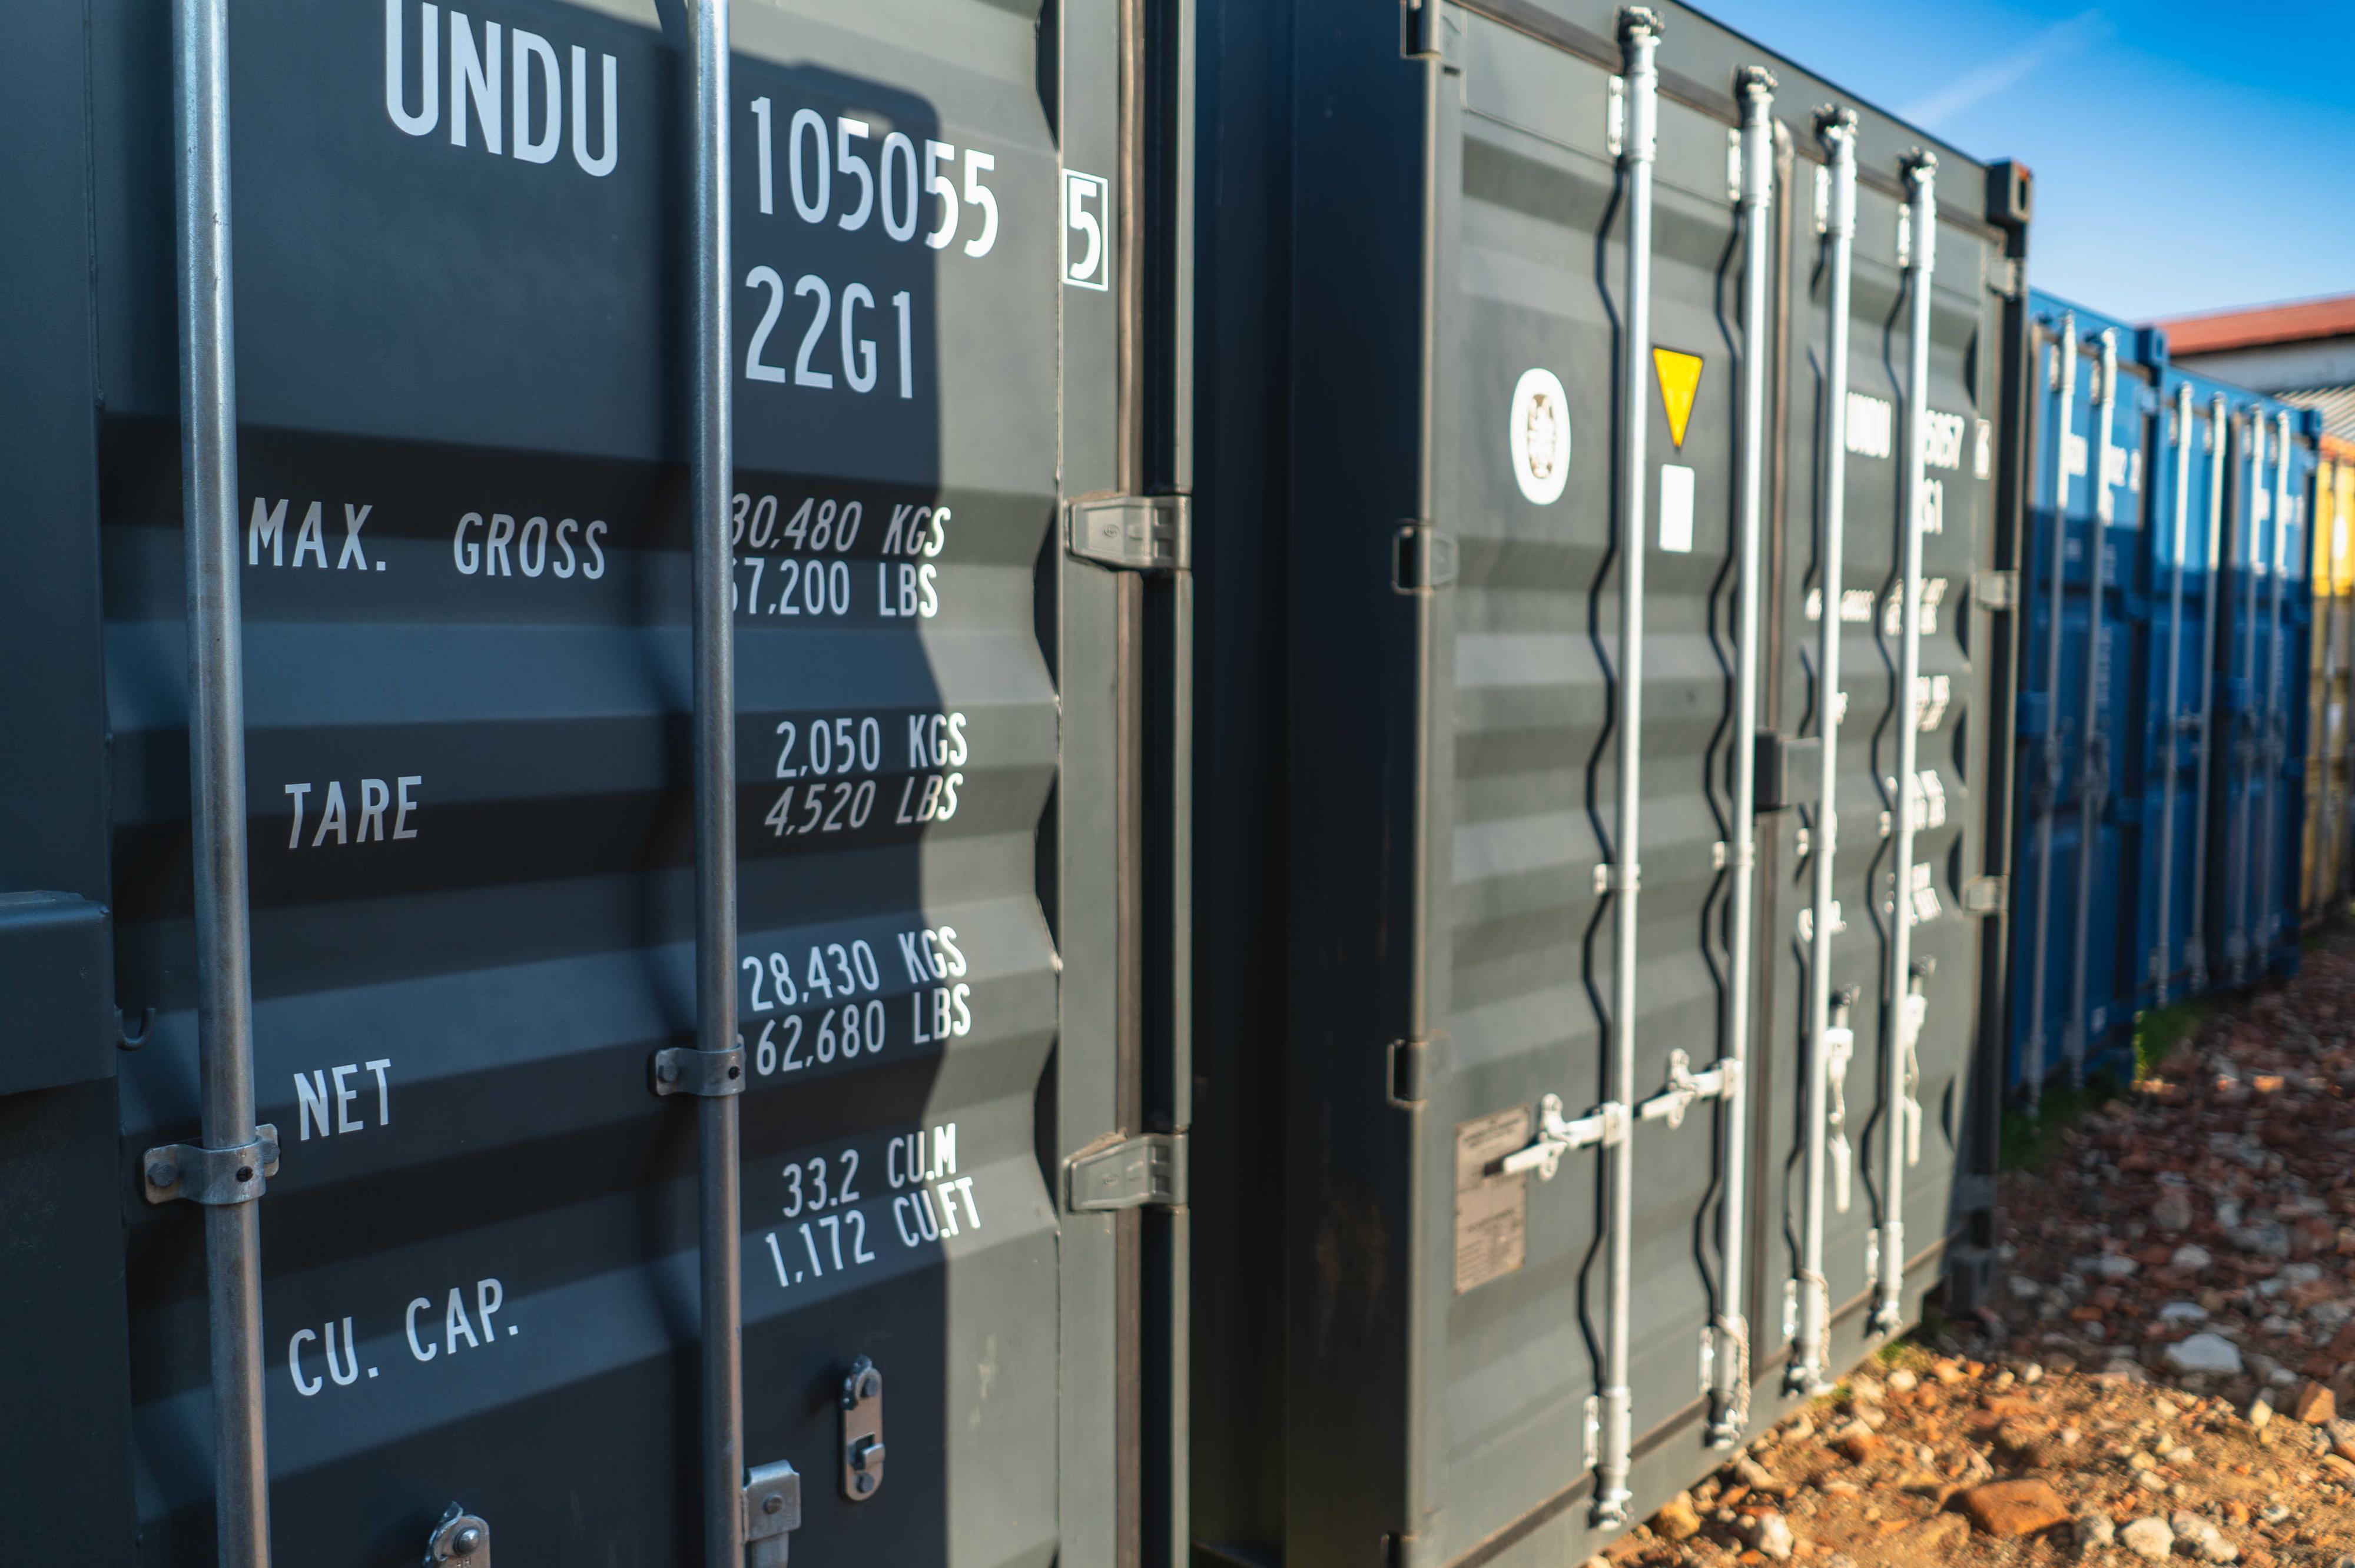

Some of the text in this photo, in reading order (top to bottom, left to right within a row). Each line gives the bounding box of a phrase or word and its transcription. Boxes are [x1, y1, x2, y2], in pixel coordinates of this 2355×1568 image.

[386, 0, 1100, 280] UNDU 105055 5
[745, 265, 913, 399] 22G1
[248, 497, 607, 580] MAX. GROSS
[732, 493, 951, 557] 30,480 KGS
[733, 557, 938, 617] 7,200 LBS
[776, 712, 967, 778] 2,050 KGS
[284, 775, 422, 849] TARE
[765, 772, 964, 836] 4,520 LBS
[742, 925, 967, 1012] 28,430 KGS
[757, 983, 971, 1075] 62,680 LBS
[293, 1058, 392, 1141] NET
[782, 1122, 956, 1217] 33.2 CU.M
[765, 1176, 981, 1287] 1,172 CU.FT
[289, 1278, 519, 1396] CU. CAP.
